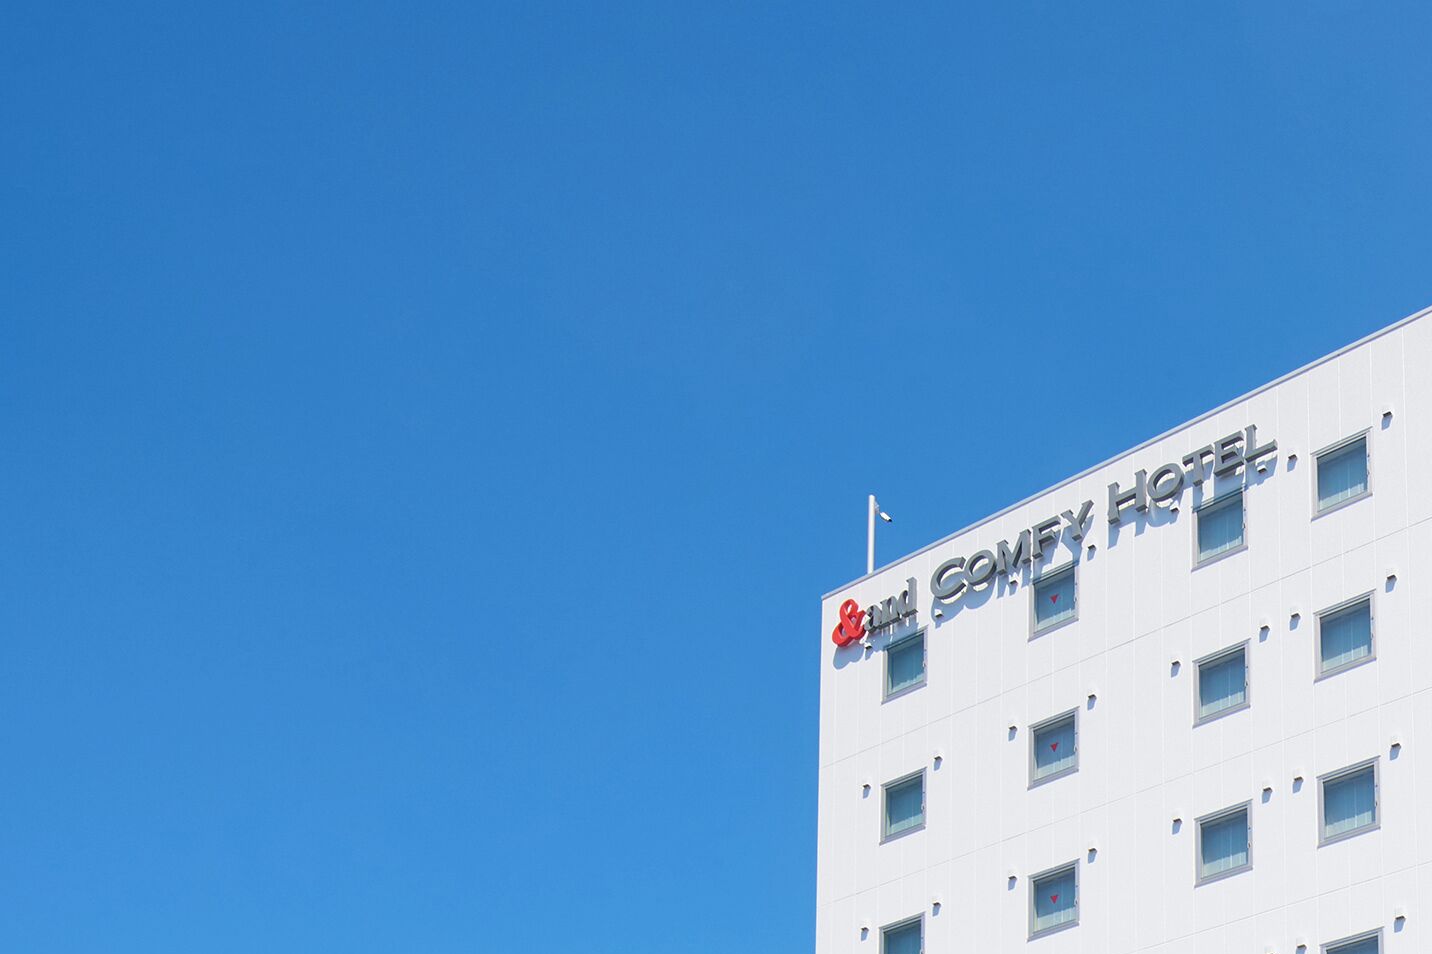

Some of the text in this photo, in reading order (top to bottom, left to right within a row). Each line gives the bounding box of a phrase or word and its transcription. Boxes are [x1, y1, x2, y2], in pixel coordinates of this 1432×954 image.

[832, 424, 1278, 647] &and COMFY HOTEL
